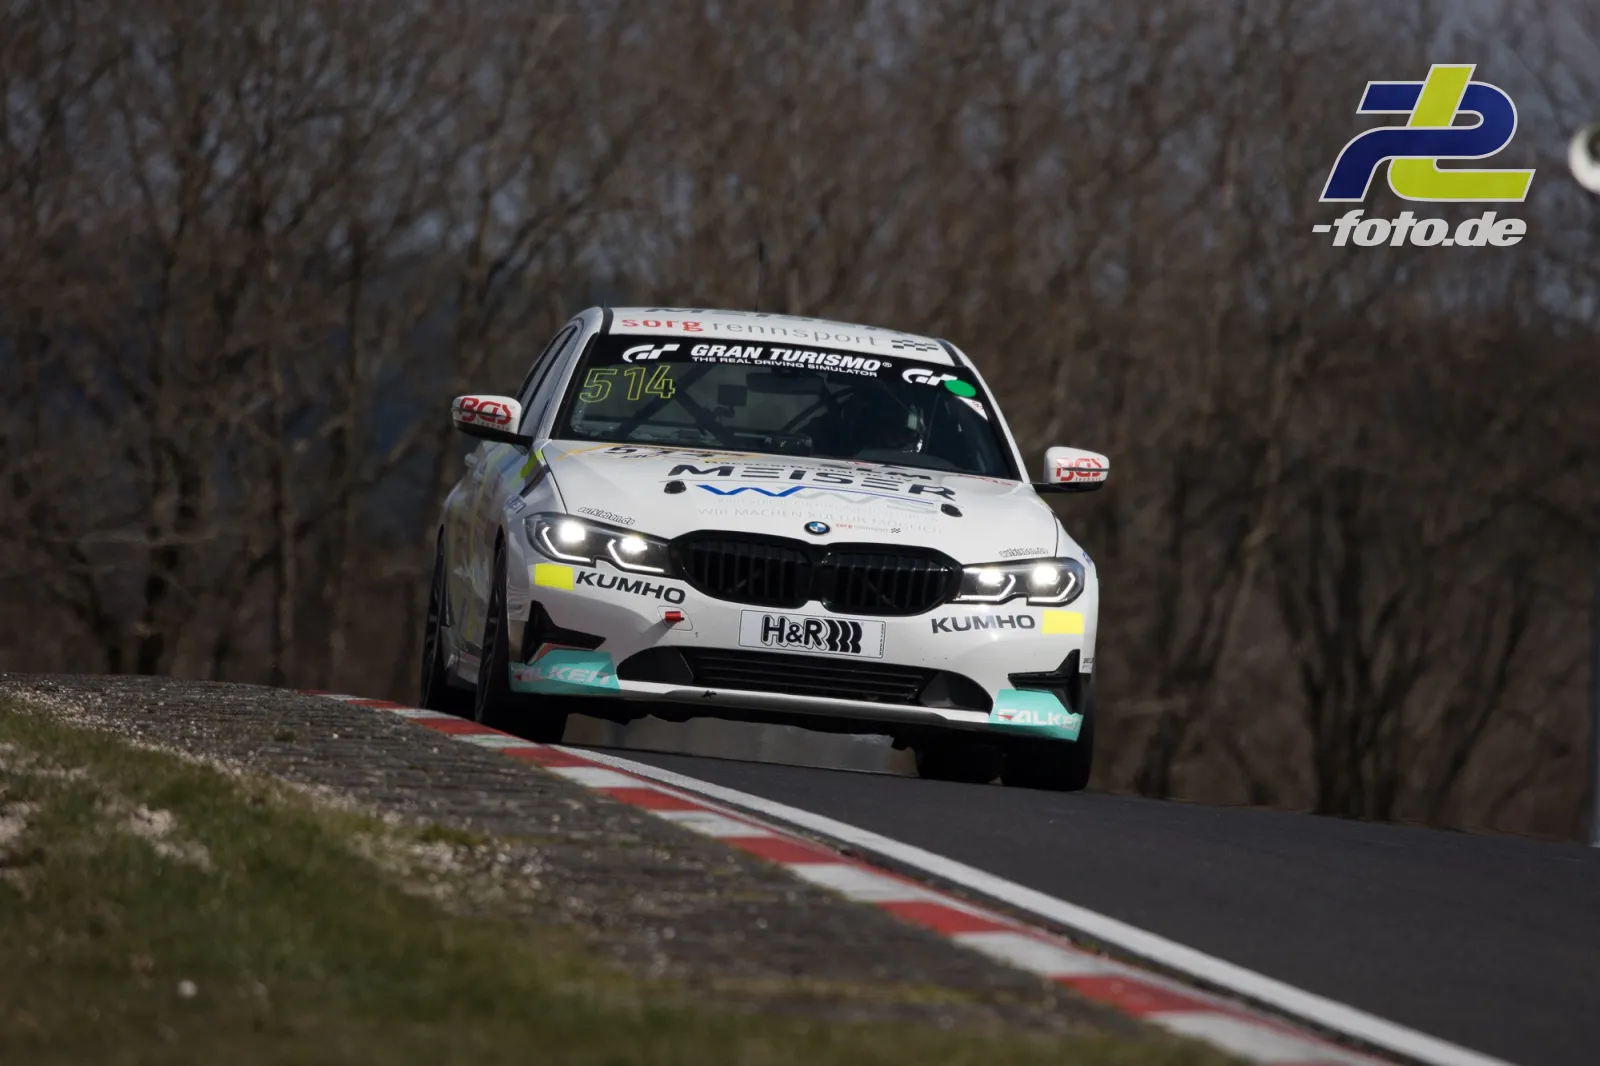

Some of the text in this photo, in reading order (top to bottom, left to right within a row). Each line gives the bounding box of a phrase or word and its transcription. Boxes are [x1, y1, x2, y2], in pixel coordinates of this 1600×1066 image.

[621, 319, 704, 332] sorg
[713, 321, 879, 346] rennsport
[691, 343, 764, 360] GRAN
[714, 357, 752, 366] REAL
[755, 359, 805, 370] DRIVING
[807, 362, 878, 378] SIMULATOR
[578, 365, 676, 403] 514
[460, 397, 513, 425] BGS
[668, 464, 957, 502] MEISER
[576, 570, 686, 605] KUMHO
[931, 613, 1036, 635] KUMHO
